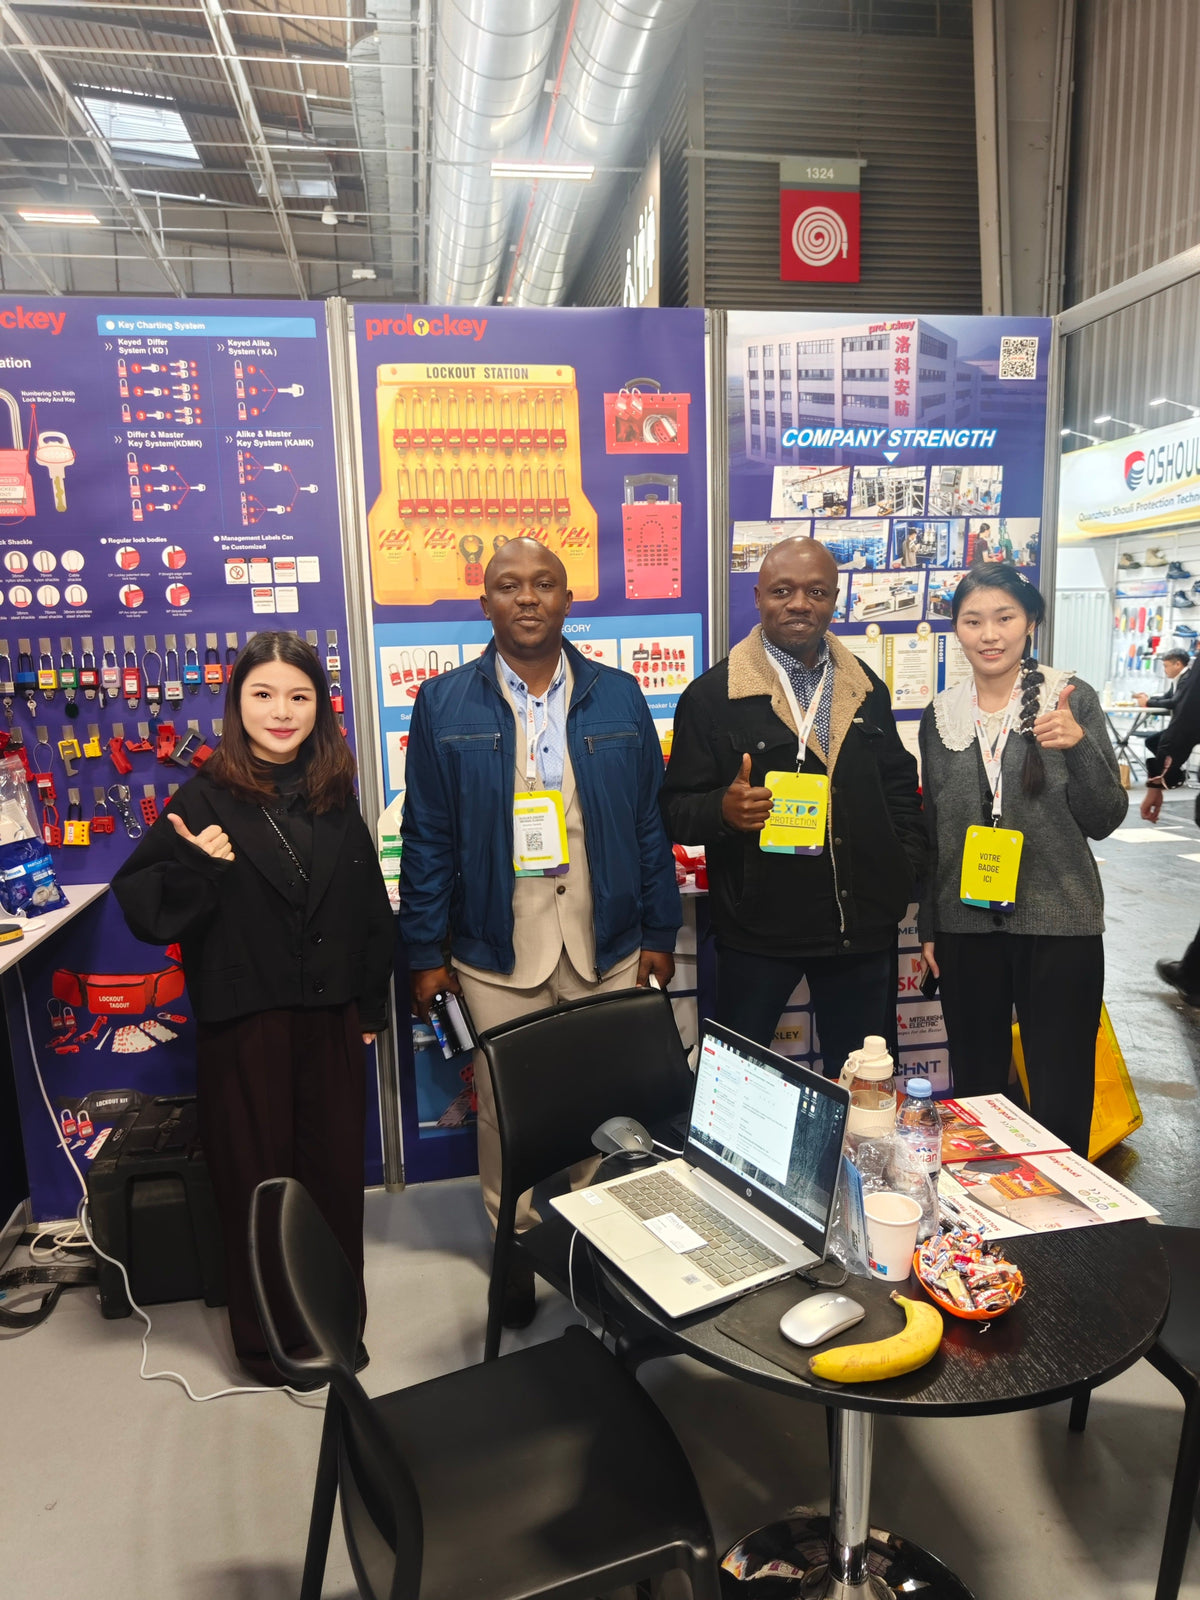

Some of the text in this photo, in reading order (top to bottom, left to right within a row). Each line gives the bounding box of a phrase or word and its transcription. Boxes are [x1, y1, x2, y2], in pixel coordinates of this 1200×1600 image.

[806, 168, 834, 179] 1324
[118, 321, 206, 332] Key Charting System
[366, 314, 487, 341] prolockey
[868, 320, 915, 334] prolockey
[118, 338, 142, 347] Keyed
[228, 340, 250, 348] Keyed
[119, 347, 146, 355] System
[228, 348, 256, 356] System
[426, 366, 529, 380] LOCKOUT STATION
[894, 335, 911, 417] 洛科安防
[236, 430, 255, 438] Alike
[782, 429, 996, 448] COMPANY STRENGTH
[128, 440, 143, 448] Key
[236, 439, 314, 448] Key System (KAMK)
[1136, 497, 1174, 512] Protection
[770, 816, 817, 827] PROTECTION
[980, 852, 1001, 863] VOTRE
[978, 863, 1000, 874] BADGE
[983, 874, 992, 884] ICI
[909, 1021, 938, 1029] ELECTRIC
[96, 1098, 118, 1107] LOCKOUT
